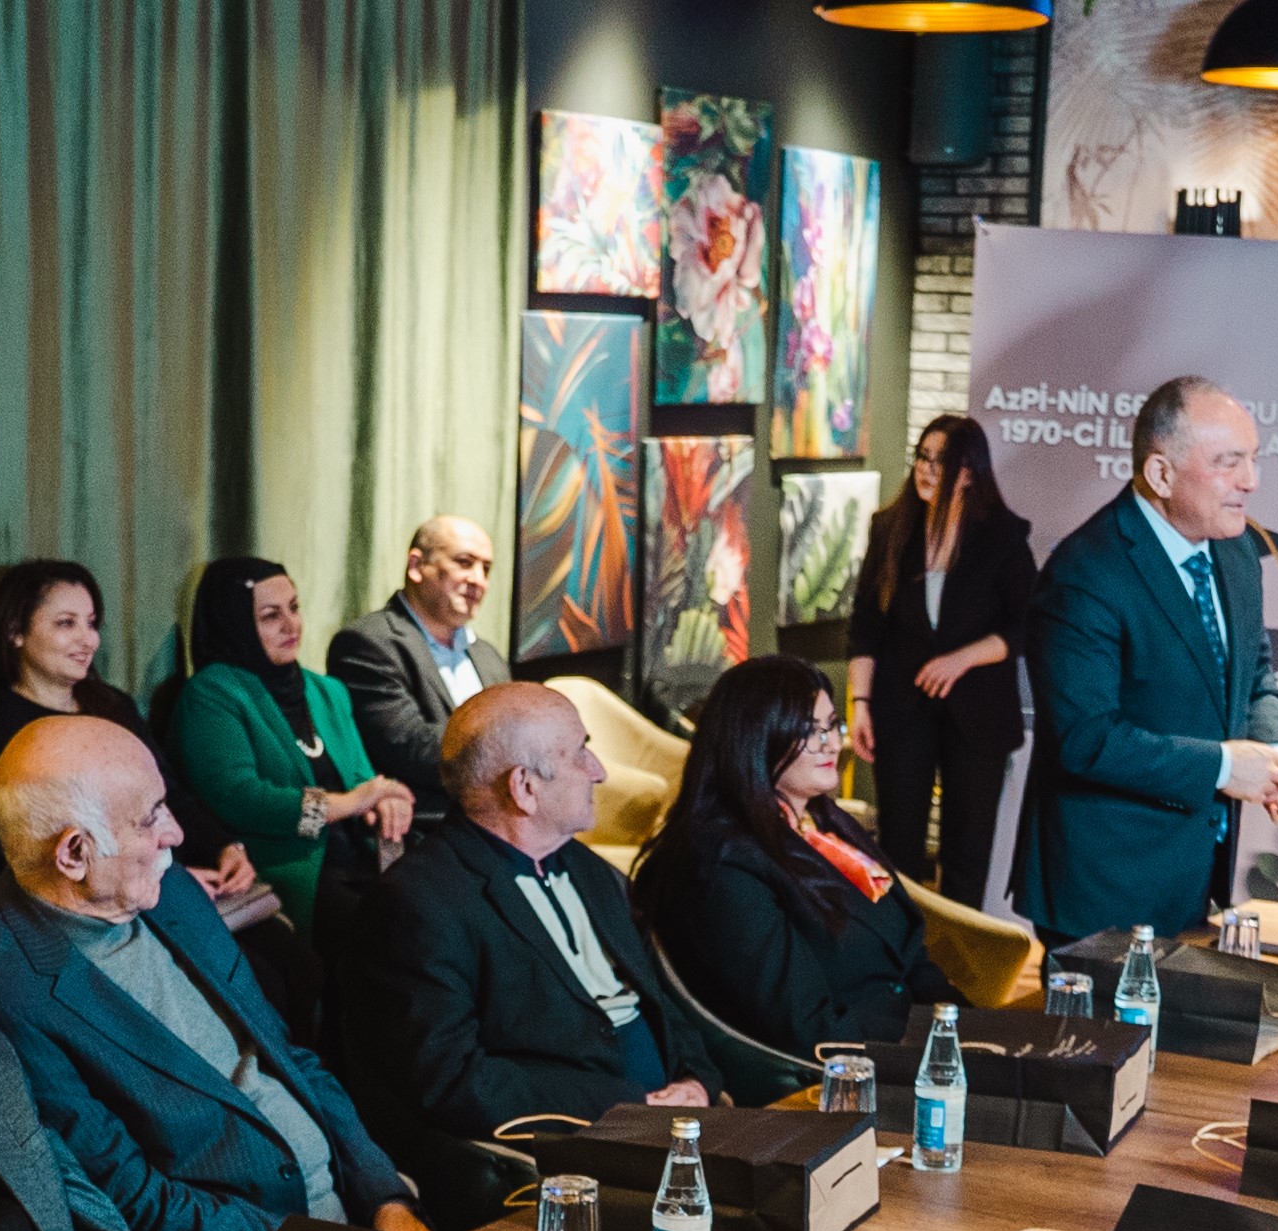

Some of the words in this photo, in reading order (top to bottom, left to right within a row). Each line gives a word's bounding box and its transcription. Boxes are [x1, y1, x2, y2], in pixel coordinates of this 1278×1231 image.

[1000, 416, 1104, 448] 1970-Cİ
[1108, 416, 1133, 449] İL
[1095, 454, 1134, 481] TO
